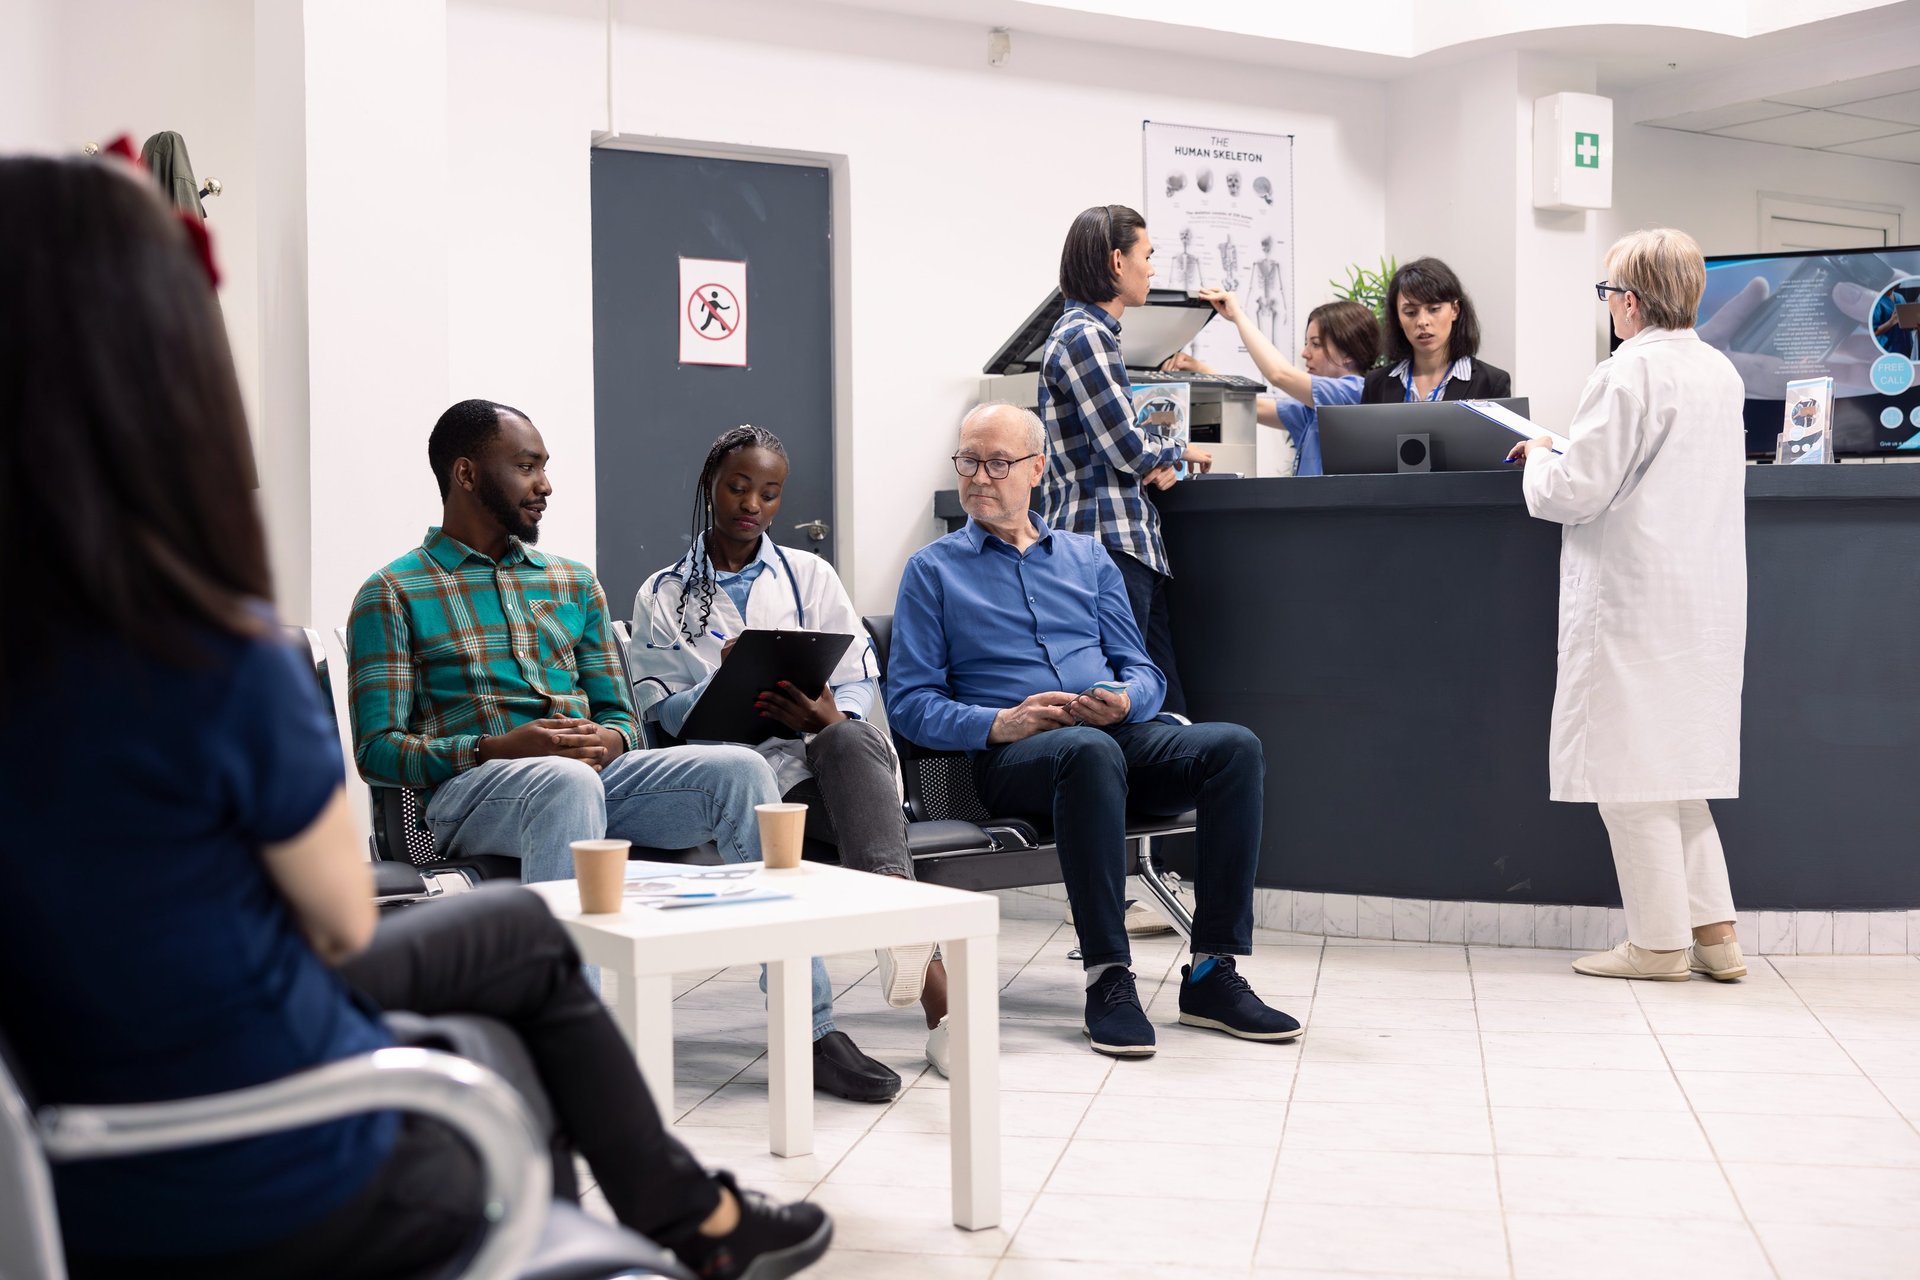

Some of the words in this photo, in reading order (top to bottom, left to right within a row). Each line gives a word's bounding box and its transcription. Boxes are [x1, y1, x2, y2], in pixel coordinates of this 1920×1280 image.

[1211, 136, 1229, 147] THE
[1174, 146, 1210, 158] HUMAN
[1213, 149, 1262, 162] SKELETON
[1878, 362, 1905, 372] FREE
[1880, 376, 1905, 385] CALL
